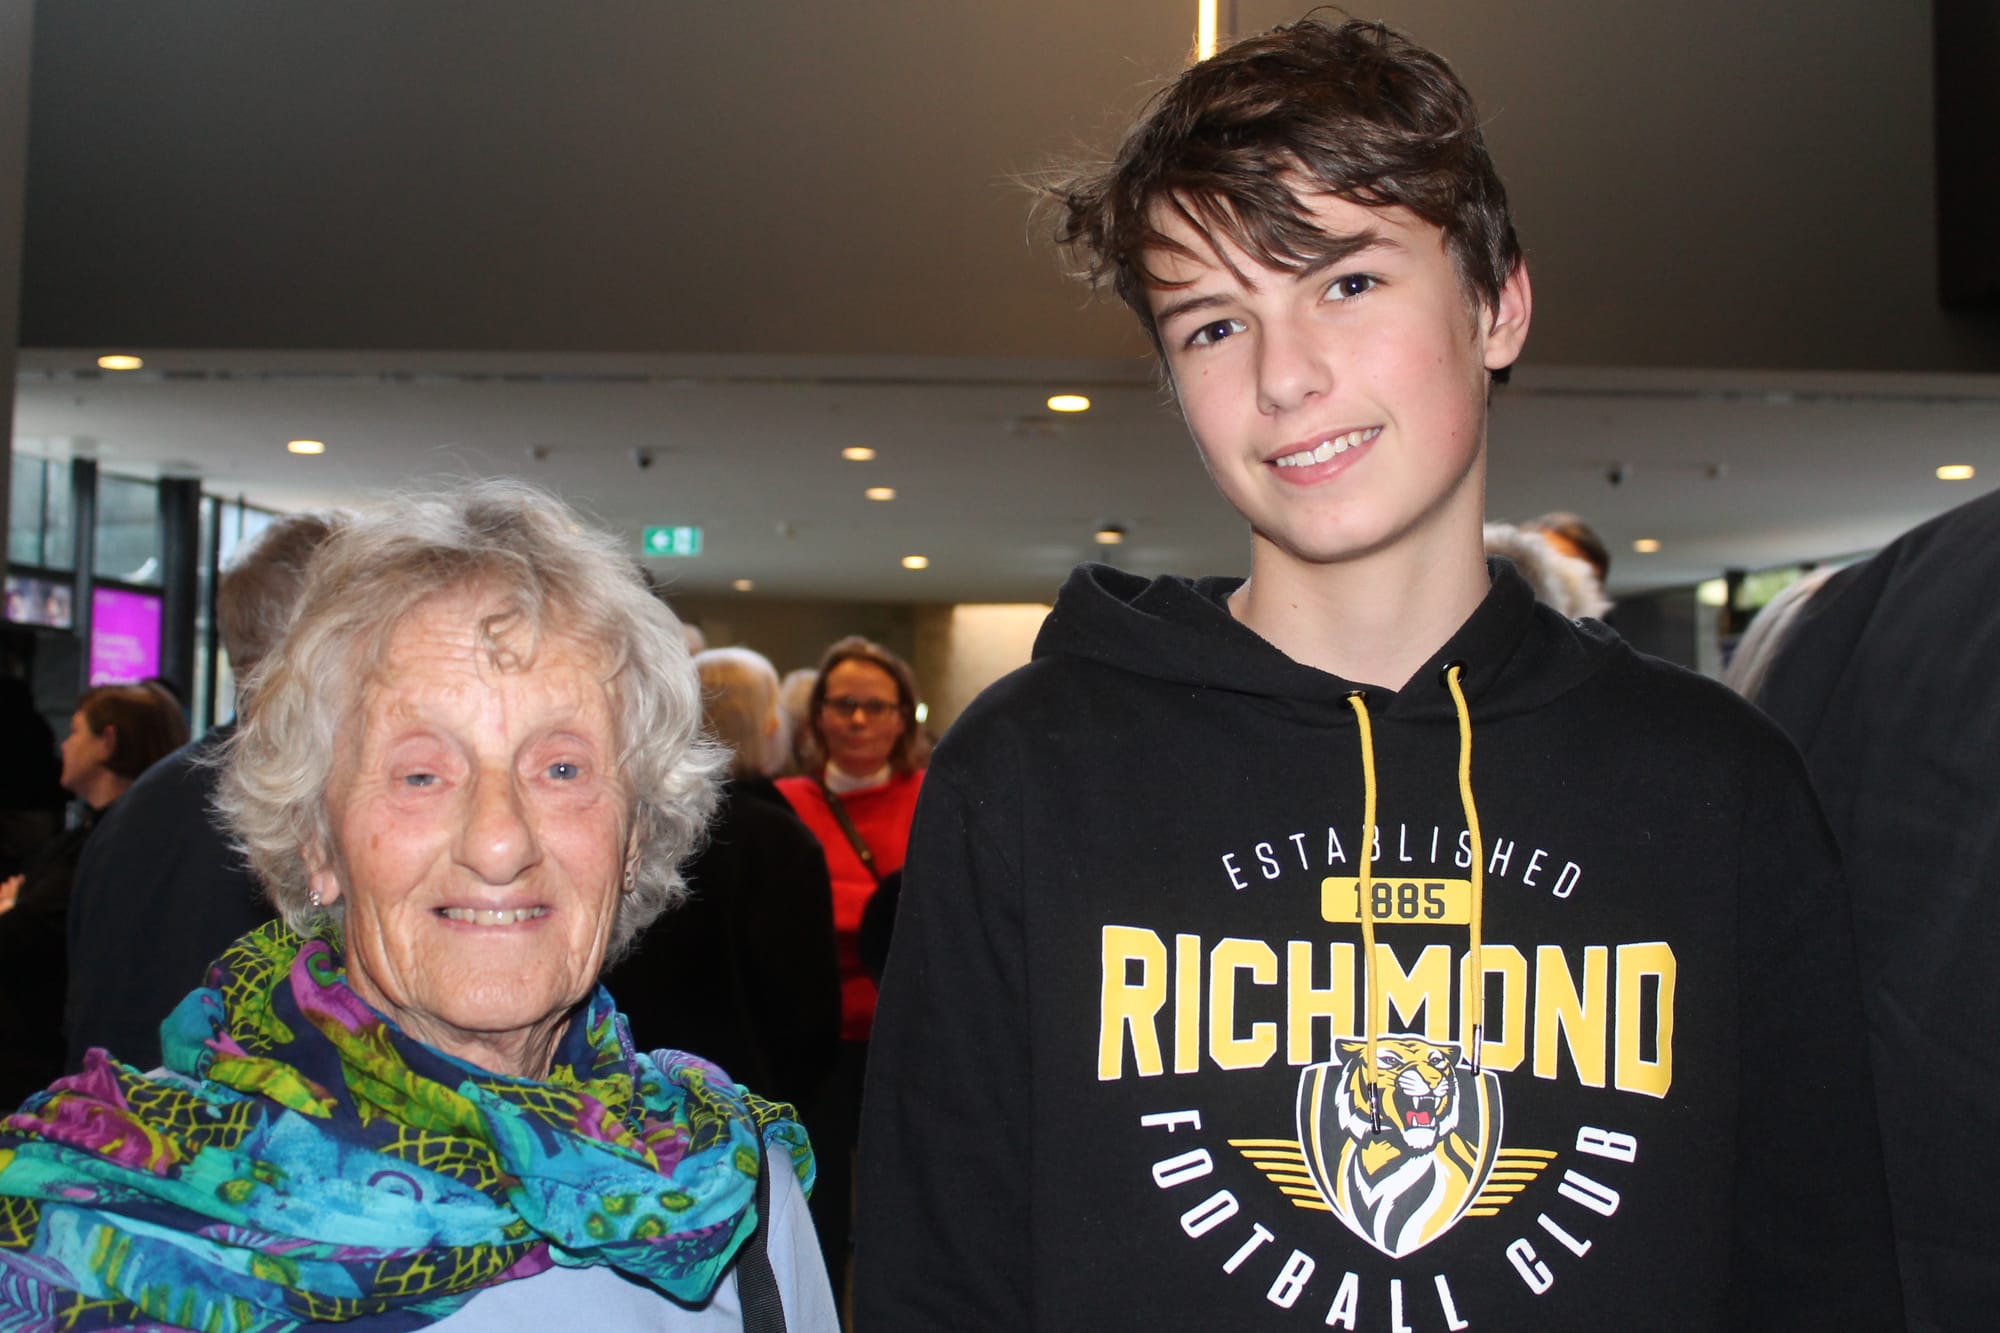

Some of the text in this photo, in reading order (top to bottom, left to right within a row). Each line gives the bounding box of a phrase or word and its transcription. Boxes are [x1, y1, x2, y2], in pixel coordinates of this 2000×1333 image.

[1098, 925, 1676, 1099] RICHMOND
[1140, 1109, 1638, 1333] FOOTBALL CLUB
